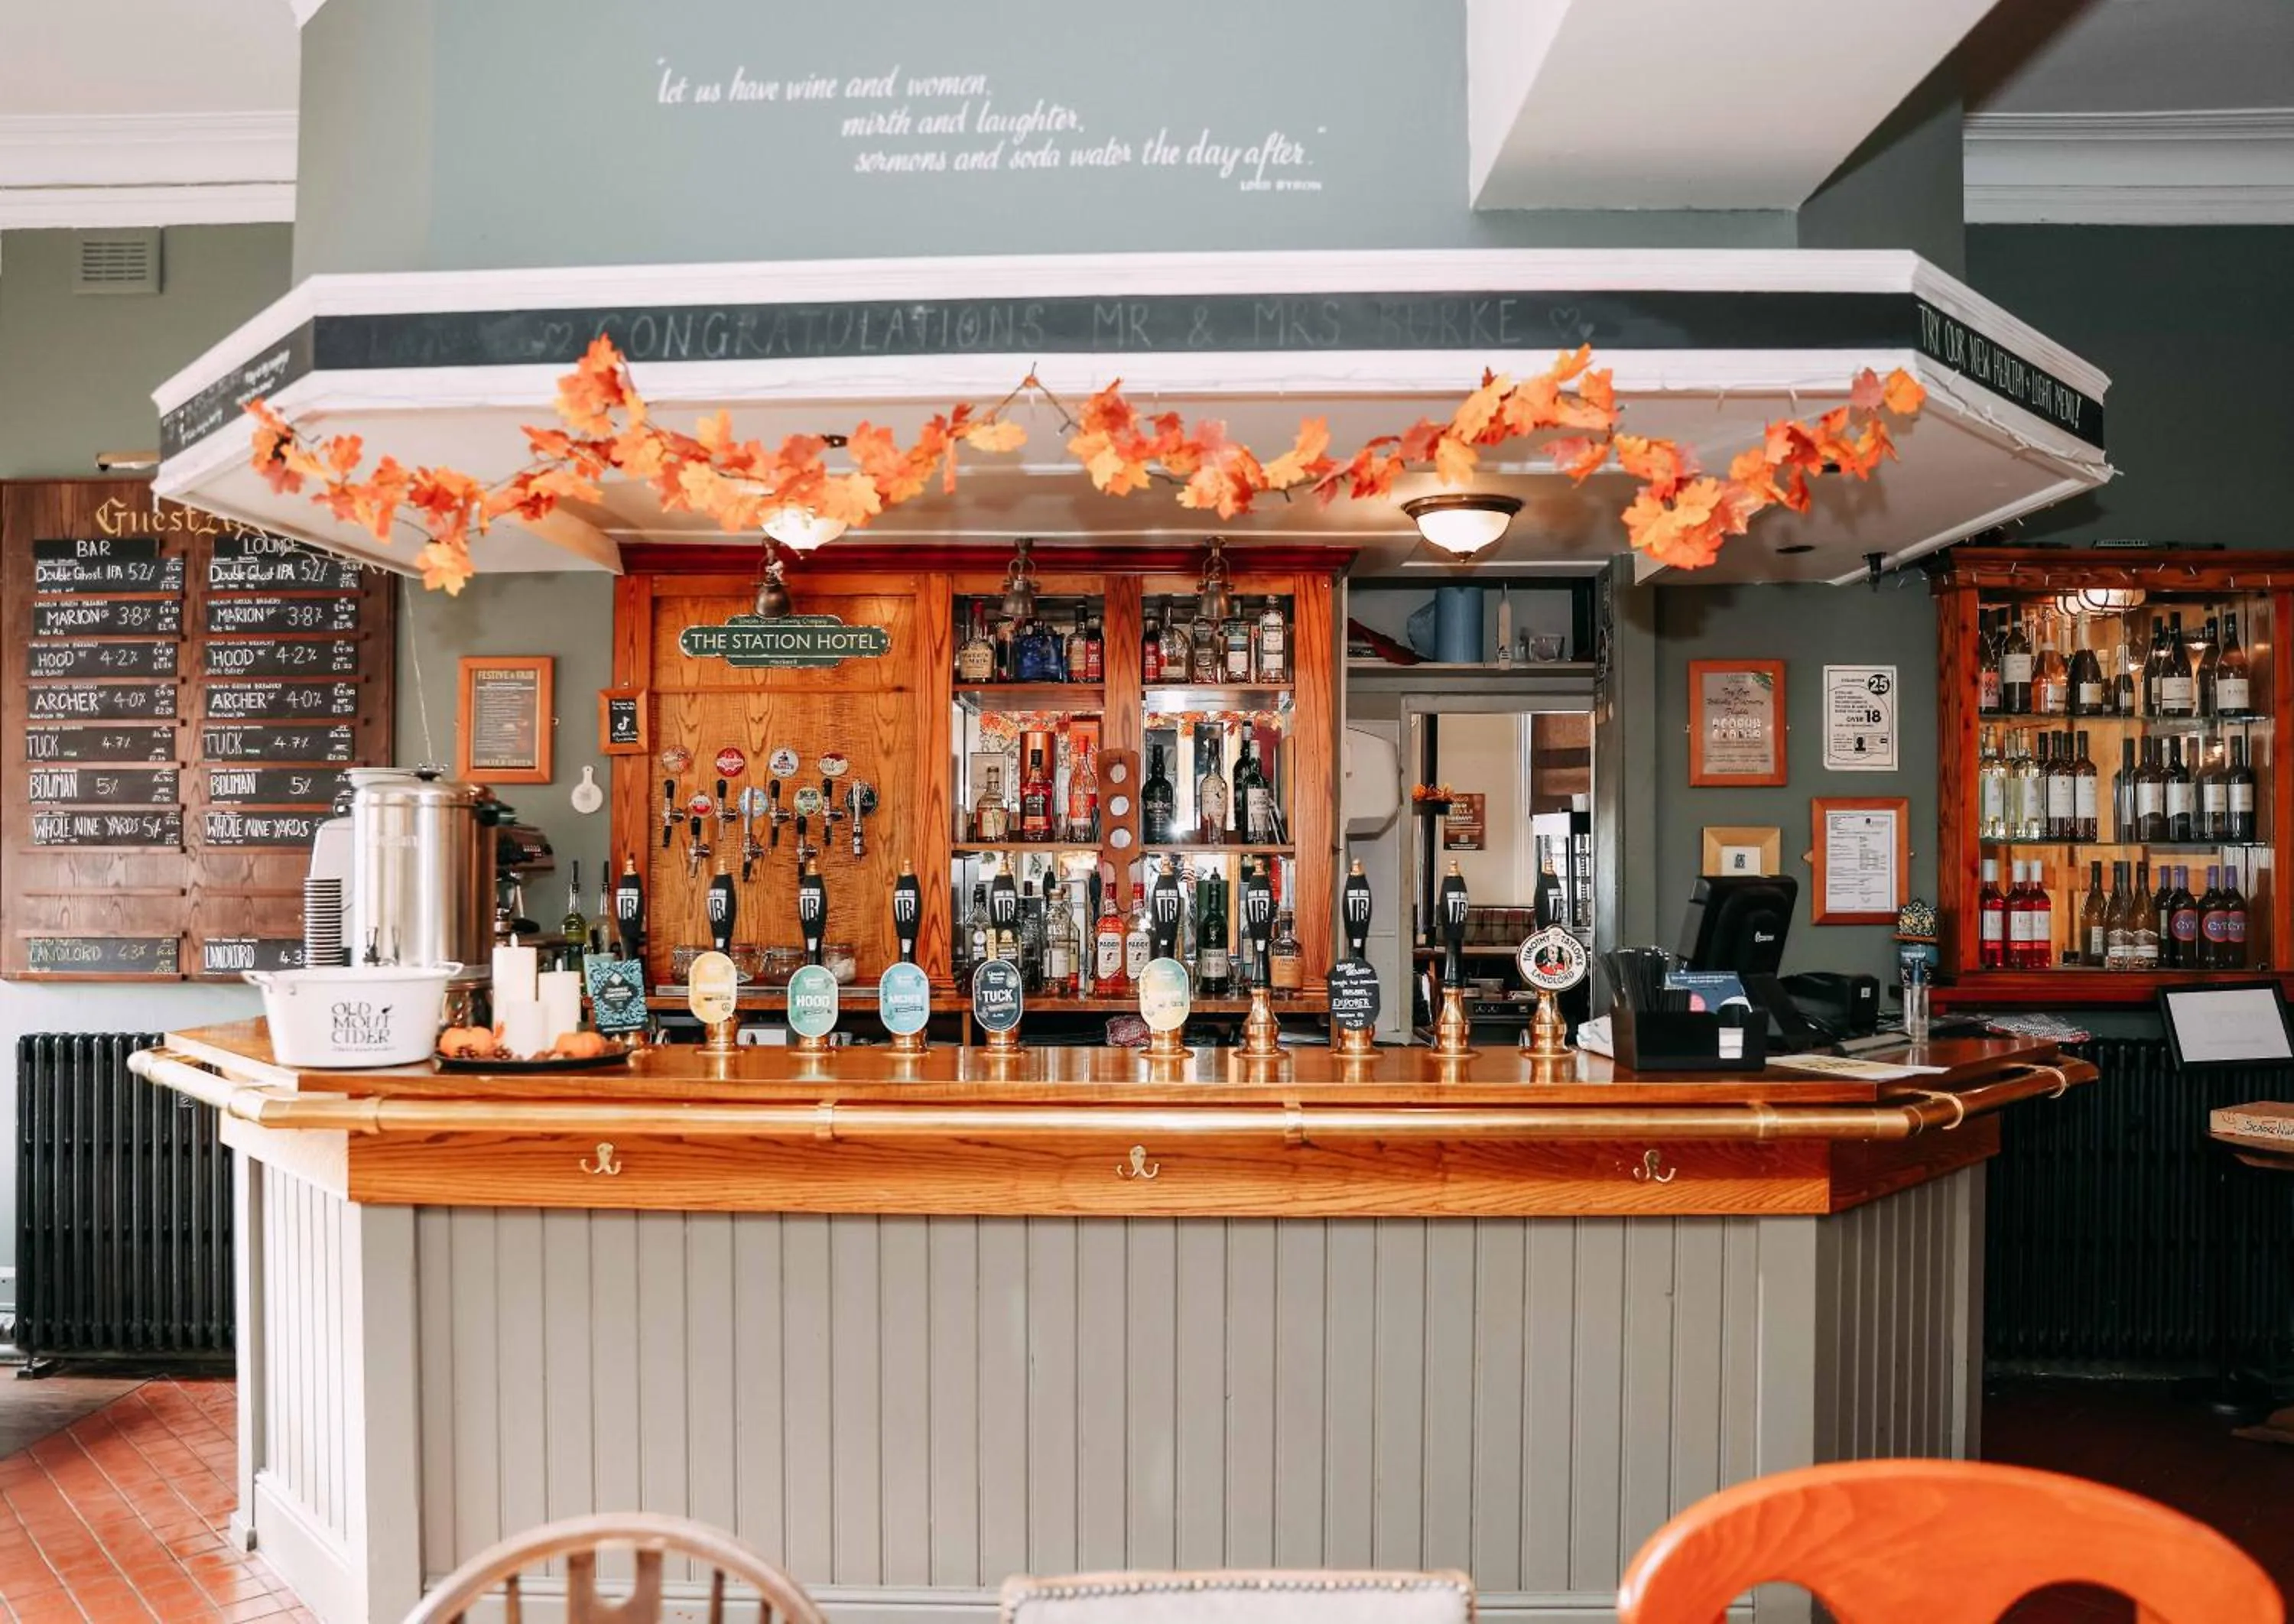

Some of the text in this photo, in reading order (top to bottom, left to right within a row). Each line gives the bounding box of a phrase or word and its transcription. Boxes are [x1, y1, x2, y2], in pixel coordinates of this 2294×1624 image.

[695, 84, 721, 102] us
[729, 67, 779, 102] have
[786, 73, 838, 101] wine
[845, 63, 900, 99] and
[842, 104, 911, 137] mirth
[918, 101, 969, 135] and
[854, 150, 946, 173] sermons
[954, 140, 1005, 171] and
[1008, 138, 1061, 170] soda
[1070, 136, 1132, 167] water
[1142, 127, 1180, 165] the
[1187, 128, 1242, 178] day
[1093, 301, 1152, 347] MR
[1188, 306, 1214, 346] &
[1253, 300, 1342, 346] MRS
[1918, 304, 1940, 356] TRY
[1945, 320, 1966, 369] OUR
[96, 497, 199, 537] Guest
[76, 540, 111, 557] BAR
[36, 565, 71, 583] Double
[74, 565, 103, 581] Ghost
[106, 565, 123, 580] IPA
[210, 565, 245, 583] Double
[249, 565, 274, 581] Ghost
[277, 563, 295, 581] IPA
[47, 609, 100, 627] MARION
[217, 608, 264, 624] MARION
[690, 634, 878, 649] THE STATION HOTEL
[38, 651, 74, 667] HOOD
[211, 649, 255, 667] HOOD
[1870, 677, 1889, 693] 25
[35, 693, 99, 712] ARCHER
[211, 693, 267, 710] ARCHER
[1864, 710, 1882, 723] 18
[26, 735, 59, 757] TUCK
[102, 736, 131, 749] 4.7%
[203, 732, 243, 755] TUCK
[274, 736, 310, 749] 4.7%
[96, 778, 119, 795] 5%
[289, 776, 311, 794] 5%
[32, 817, 73, 839] WHOLE
[74, 816, 100, 836] NINE
[105, 817, 141, 836] YARDS
[206, 816, 310, 838] WHOLE NINE YARDS
[29, 944, 101, 963] LANDLORD
[1531, 969, 1574, 984] LANDLORD
[796, 995, 831, 1008] HOOD
[982, 989, 1013, 1003] TUCK
[331, 1002, 372, 1017] OLD
[333, 1015, 394, 1028] MOUT
[331, 1029, 391, 1044] CIDER
